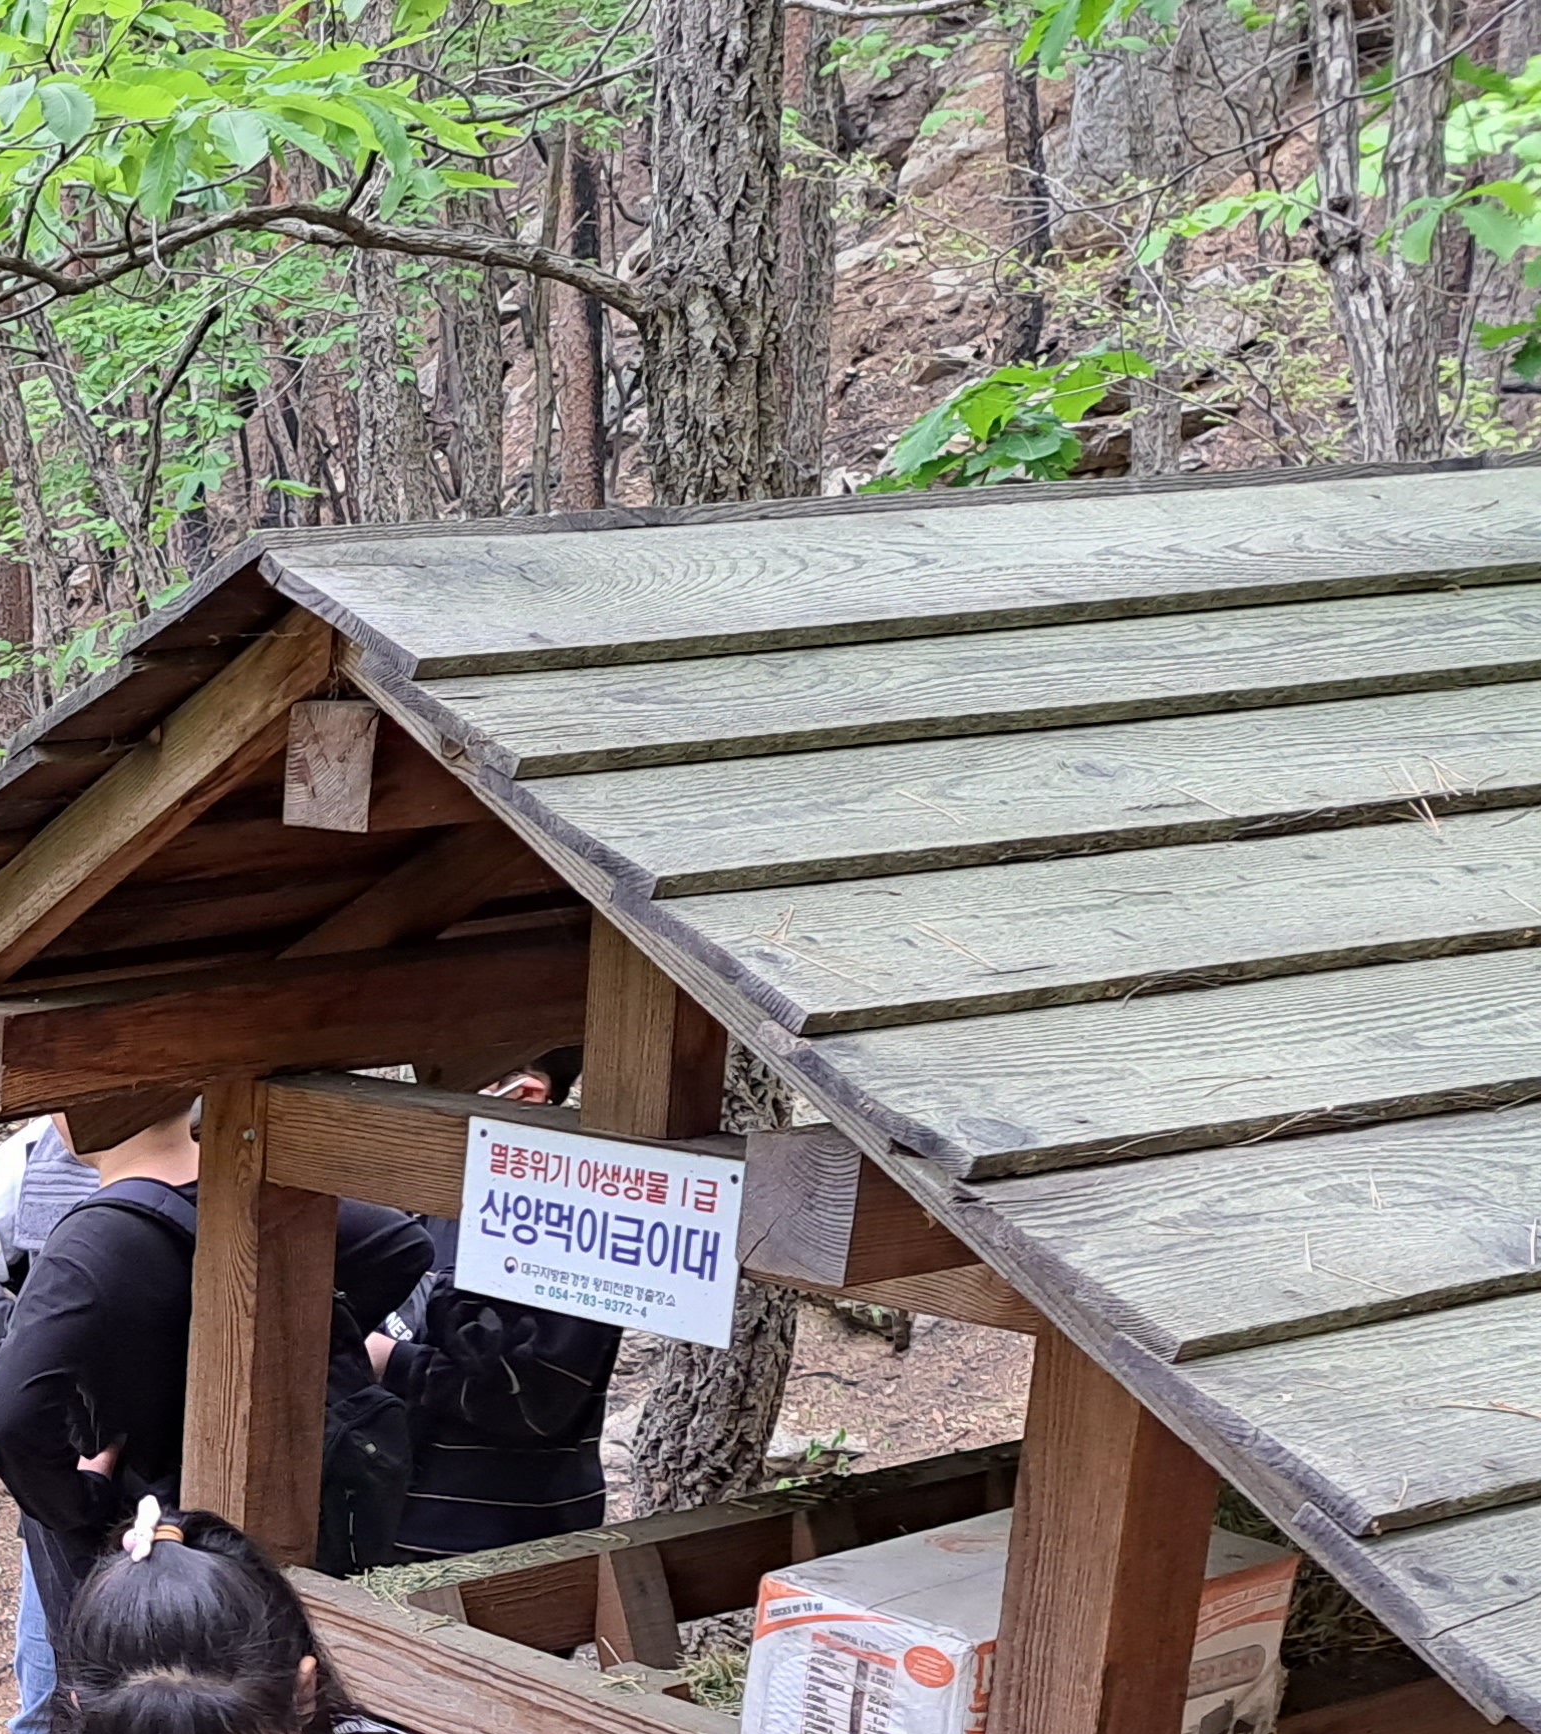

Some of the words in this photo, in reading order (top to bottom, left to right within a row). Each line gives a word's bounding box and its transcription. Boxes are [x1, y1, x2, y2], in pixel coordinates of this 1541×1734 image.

[490, 1142, 571, 1188] 멸종위기
[577, 1159, 669, 1205] 야생생물
[479, 1189, 721, 1282] 산양먹이급이대
